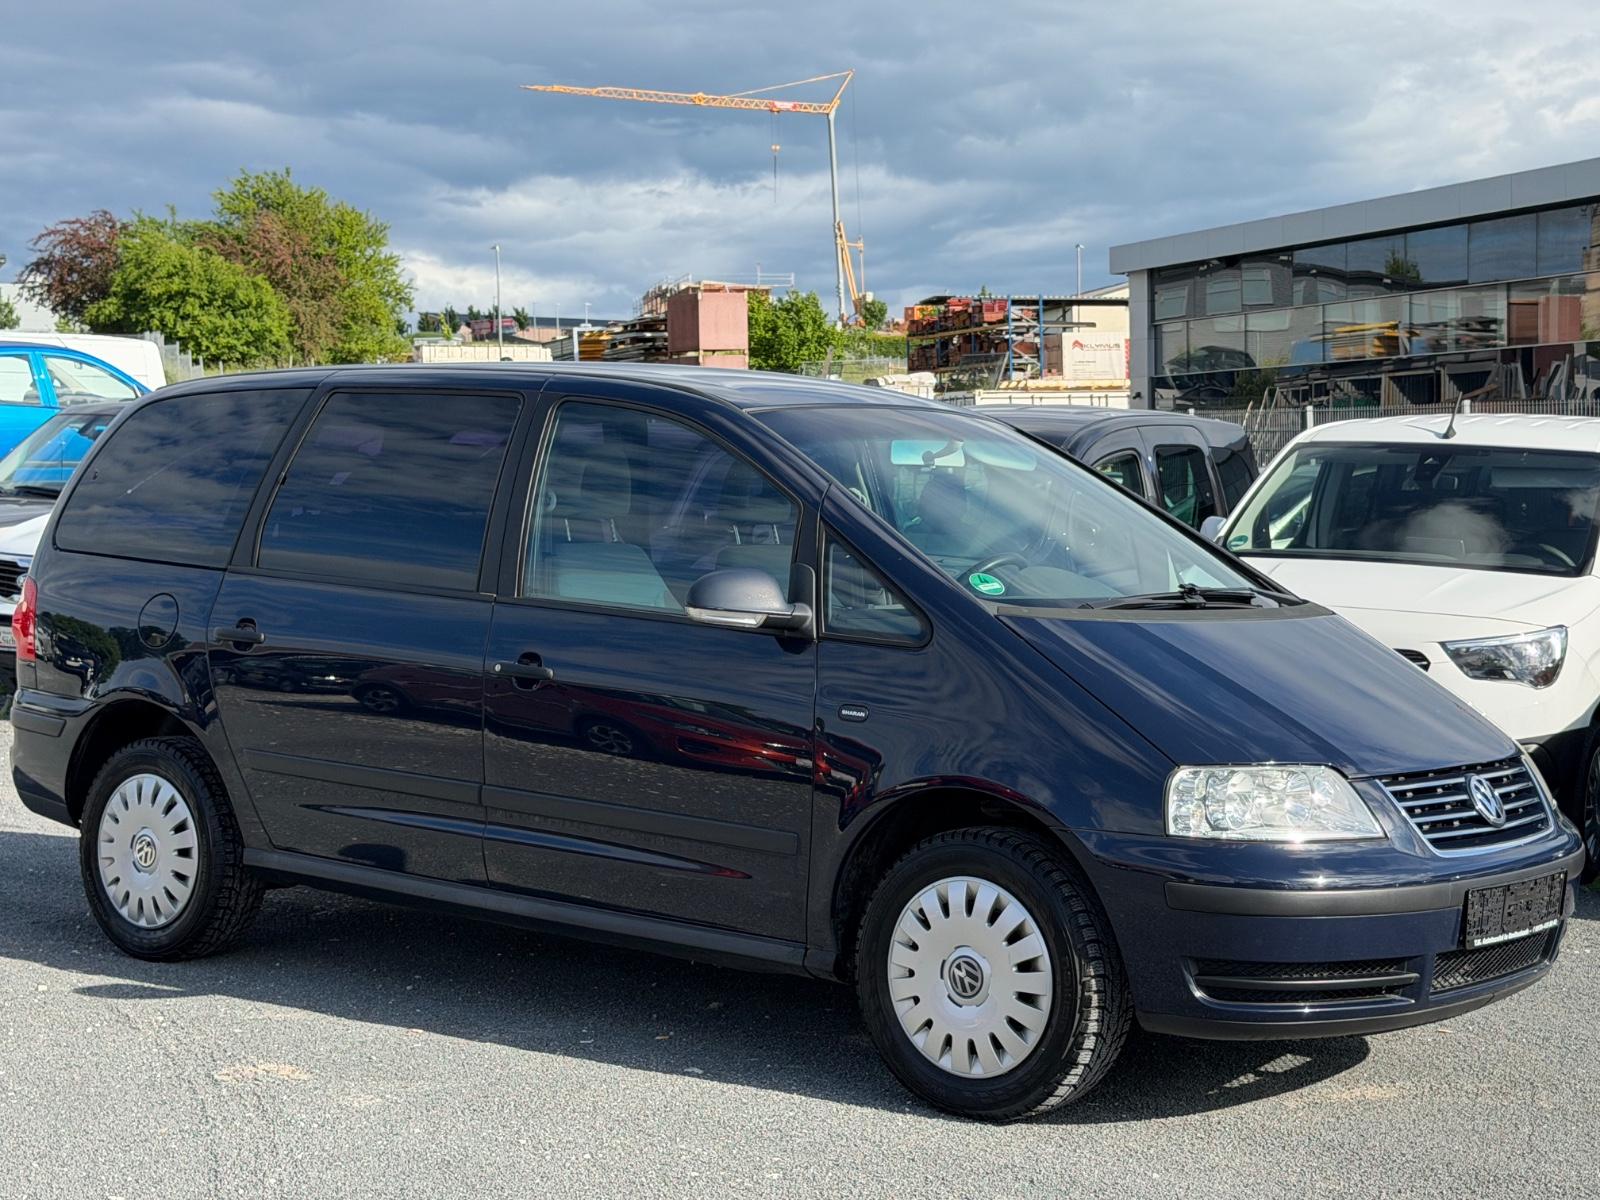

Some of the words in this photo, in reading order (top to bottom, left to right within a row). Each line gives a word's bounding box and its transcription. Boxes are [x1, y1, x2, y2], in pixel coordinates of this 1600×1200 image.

[841, 709, 866, 717] SHARAN
[1470, 776, 1505, 824] VW
[950, 957, 983, 998] VW
